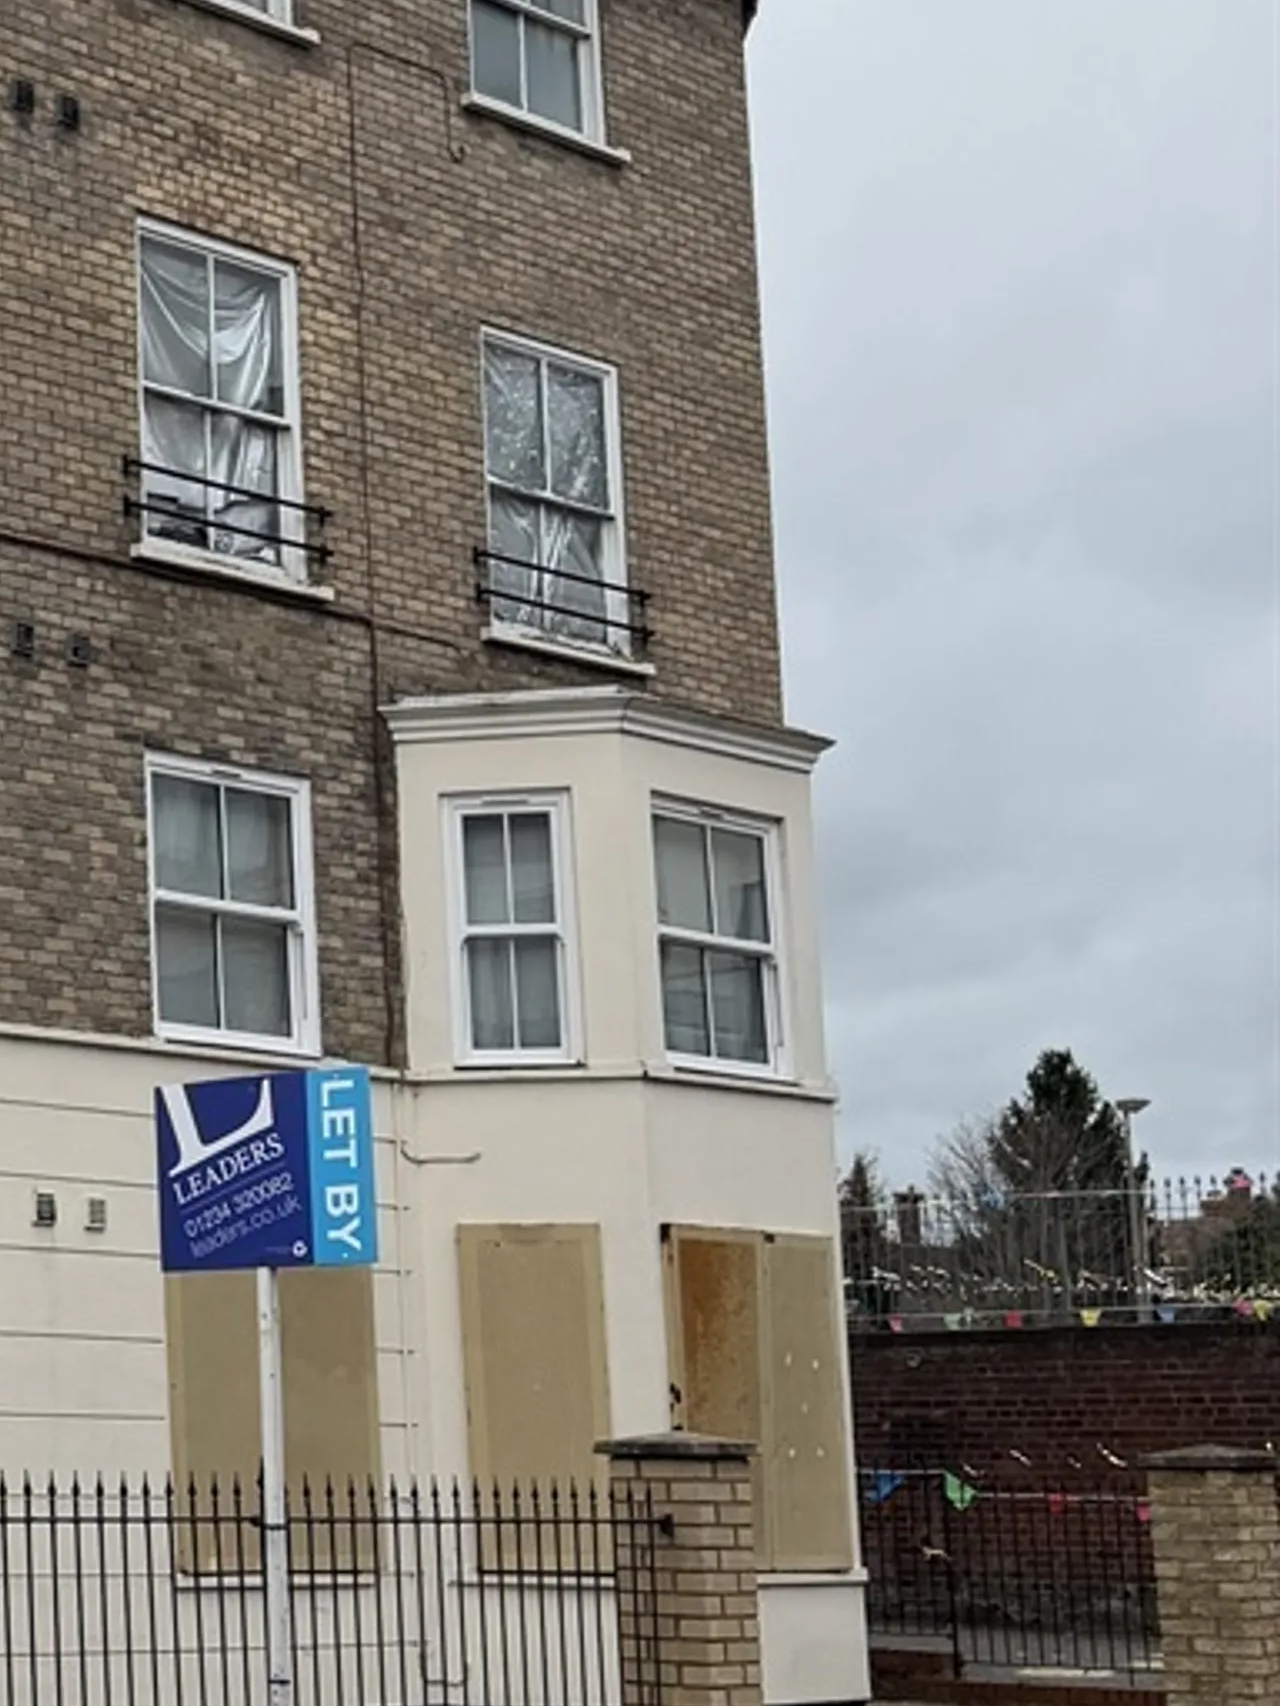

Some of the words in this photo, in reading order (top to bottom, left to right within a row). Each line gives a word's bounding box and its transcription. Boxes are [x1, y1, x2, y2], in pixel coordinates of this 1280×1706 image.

[321, 1079, 357, 1169] LET
[173, 1131, 286, 1205] LEADERS
[183, 1201, 233, 1238] 01234
[232, 1171, 295, 1213] 320082
[324, 1183, 362, 1251] BY
